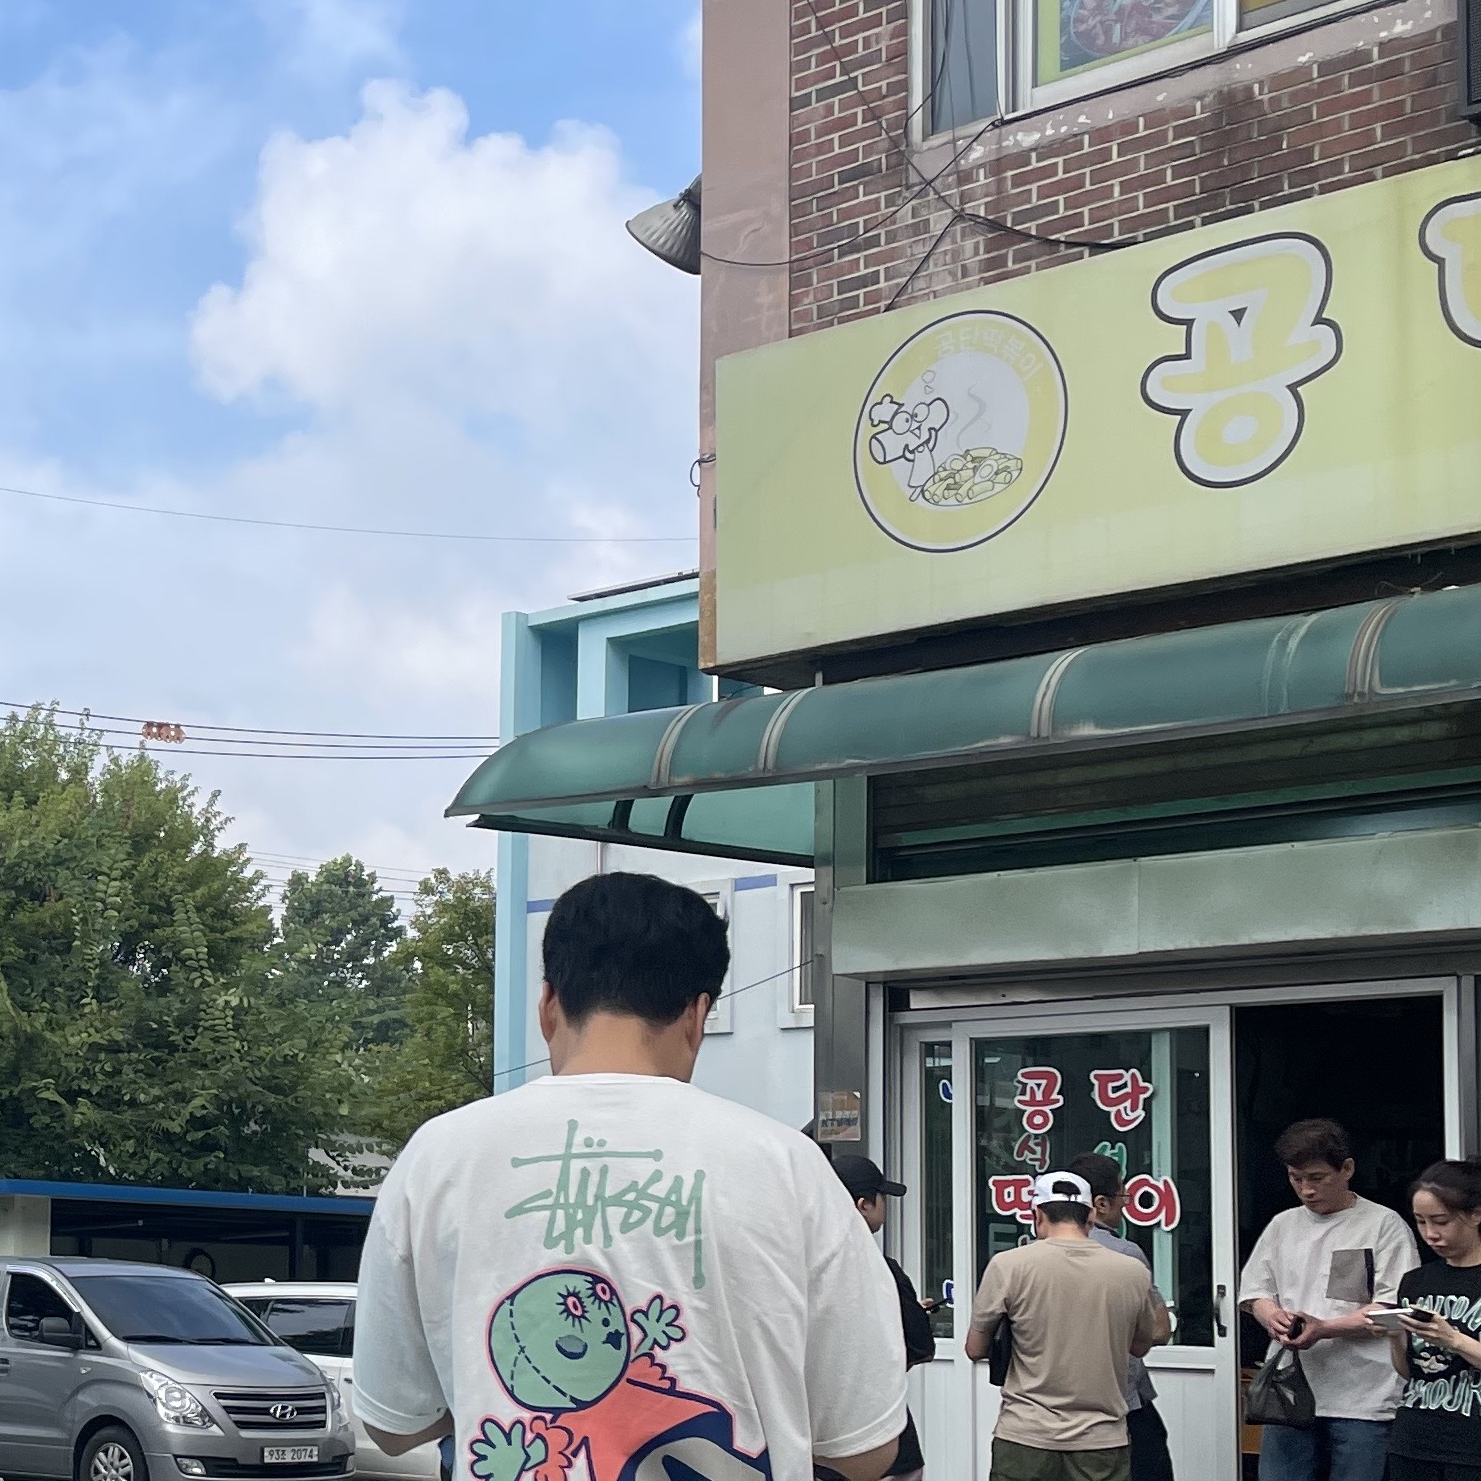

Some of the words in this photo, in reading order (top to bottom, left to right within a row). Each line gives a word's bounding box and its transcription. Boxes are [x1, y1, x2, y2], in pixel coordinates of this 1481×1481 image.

[935, 325, 1045, 382] 공단떡볶이
[1014, 1066, 1154, 1134] 공단
[988, 1174, 1181, 1239] 떡이
[290, 1448, 314, 1460] 2074
